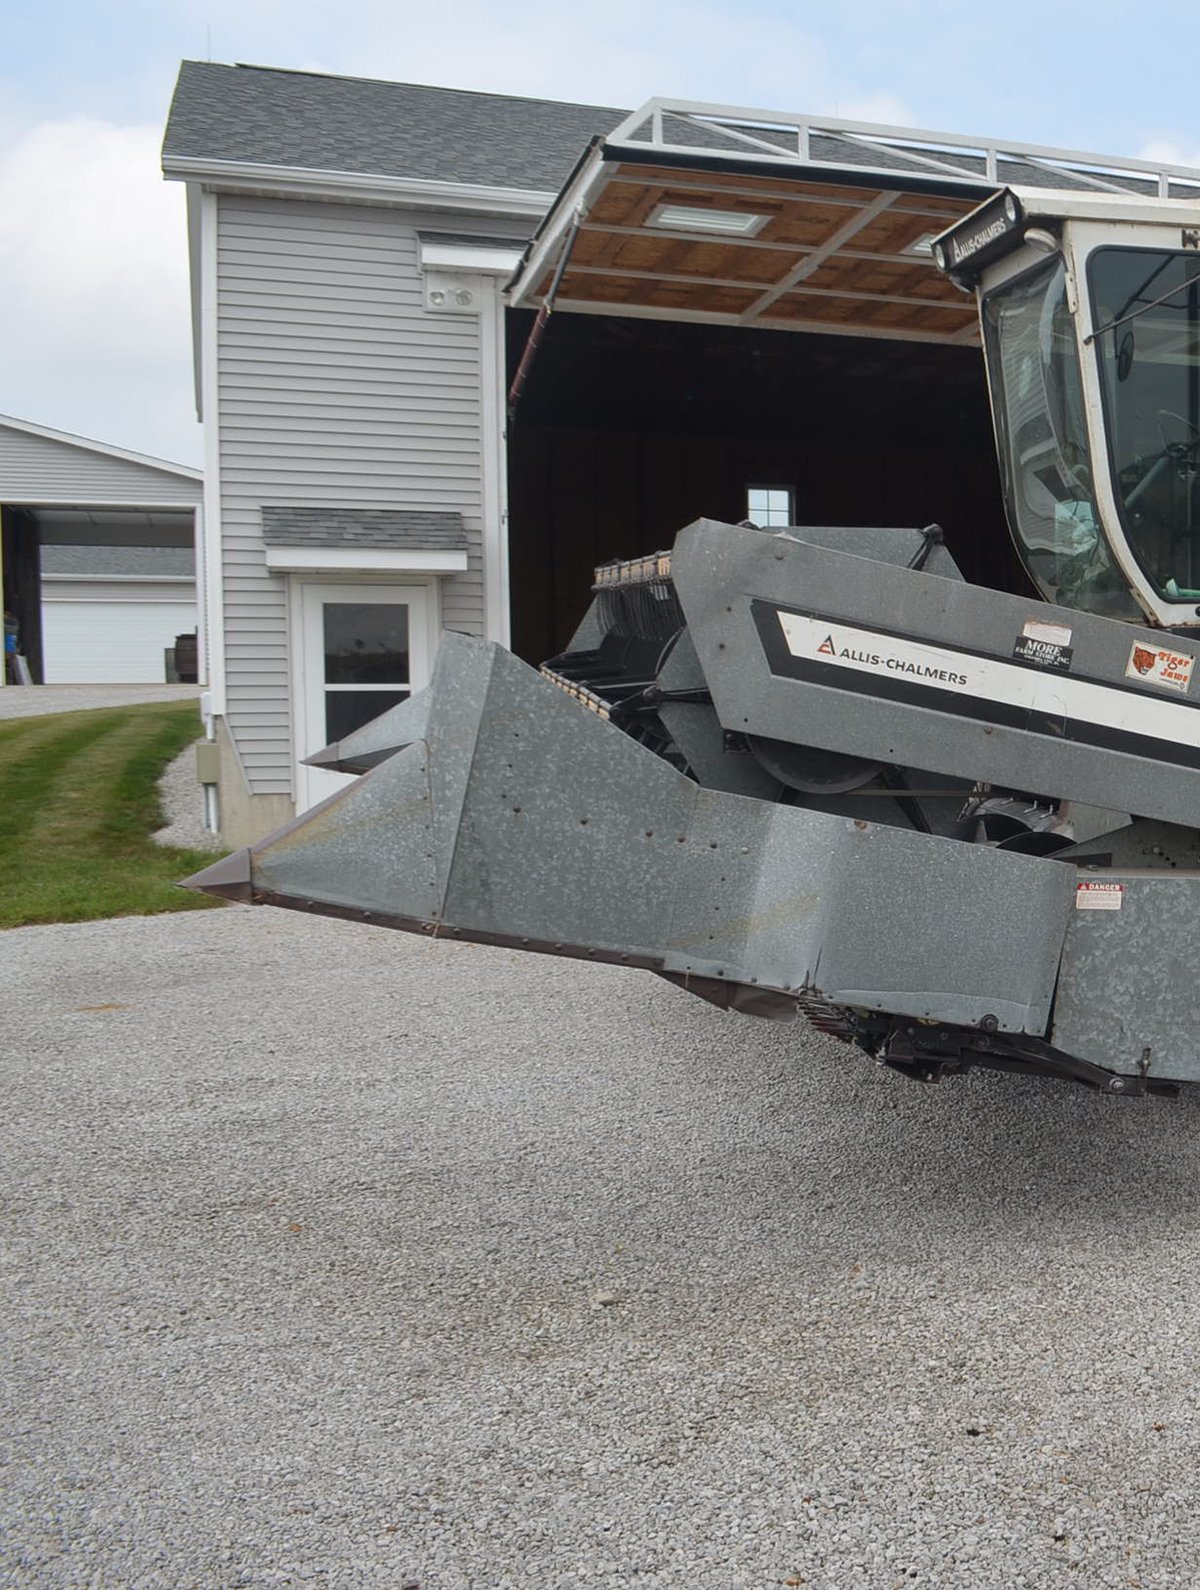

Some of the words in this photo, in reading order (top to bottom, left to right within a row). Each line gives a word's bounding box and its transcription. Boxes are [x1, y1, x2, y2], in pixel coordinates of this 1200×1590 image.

[959, 217, 1006, 260] ALLIS-CHALMERS
[1024, 640, 1063, 656] MORE
[839, 648, 968, 686] ALLIS-CHALMERS
[1158, 651, 1190, 670] Tiger
[1160, 668, 1188, 682] Jaws
